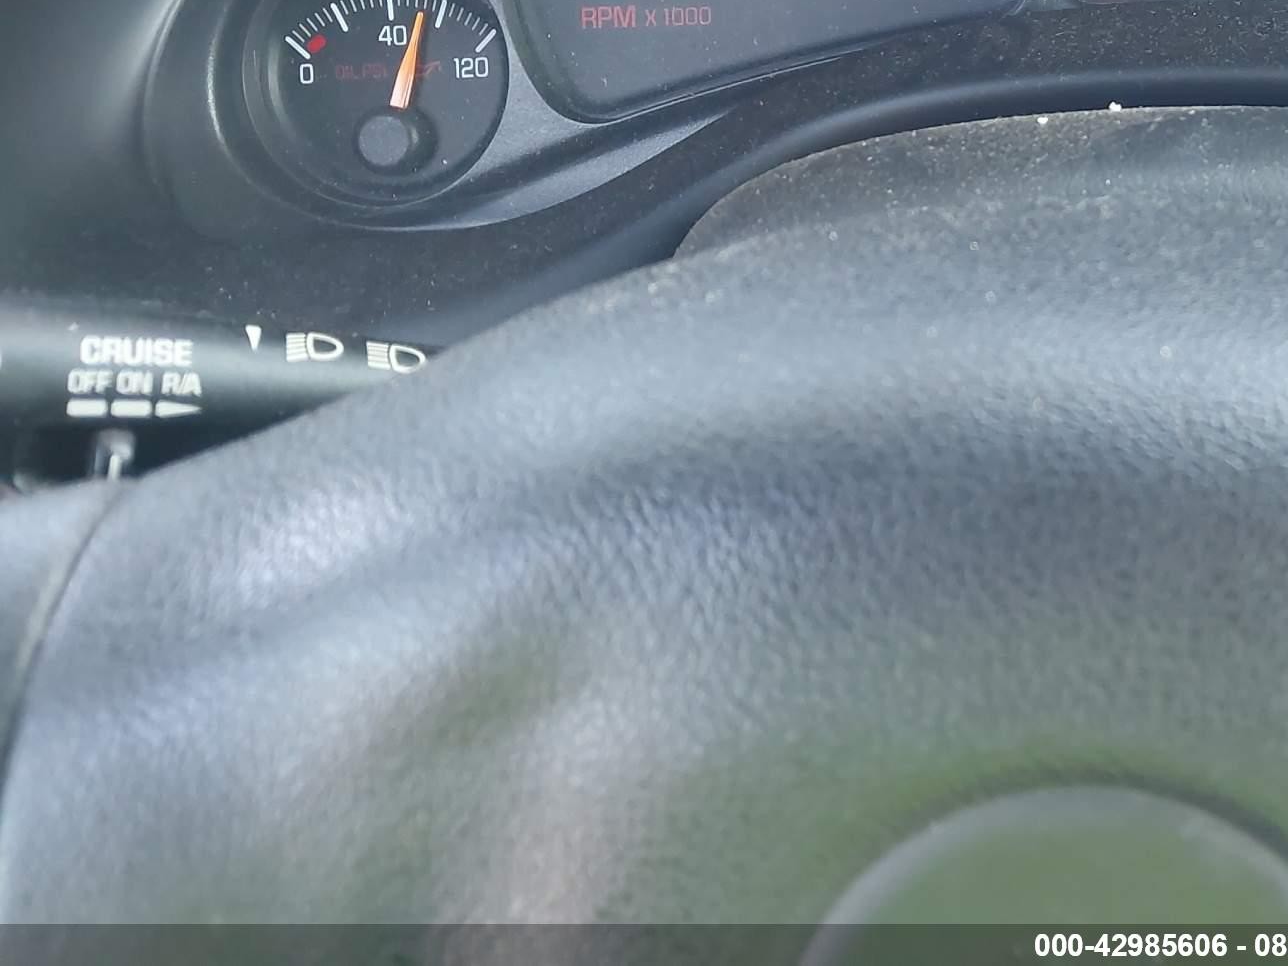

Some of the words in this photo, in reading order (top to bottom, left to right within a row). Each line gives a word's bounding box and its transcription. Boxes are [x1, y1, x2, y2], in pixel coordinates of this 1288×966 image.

[581, 6, 636, 29] RPM
[663, 7, 712, 27] 1000
[378, 25, 407, 46] 40
[299, 63, 314, 84] 0
[453, 57, 489, 79] 120
[80, 335, 194, 366] CRUISE
[67, 370, 112, 395] OFF
[116, 370, 153, 395] ON
